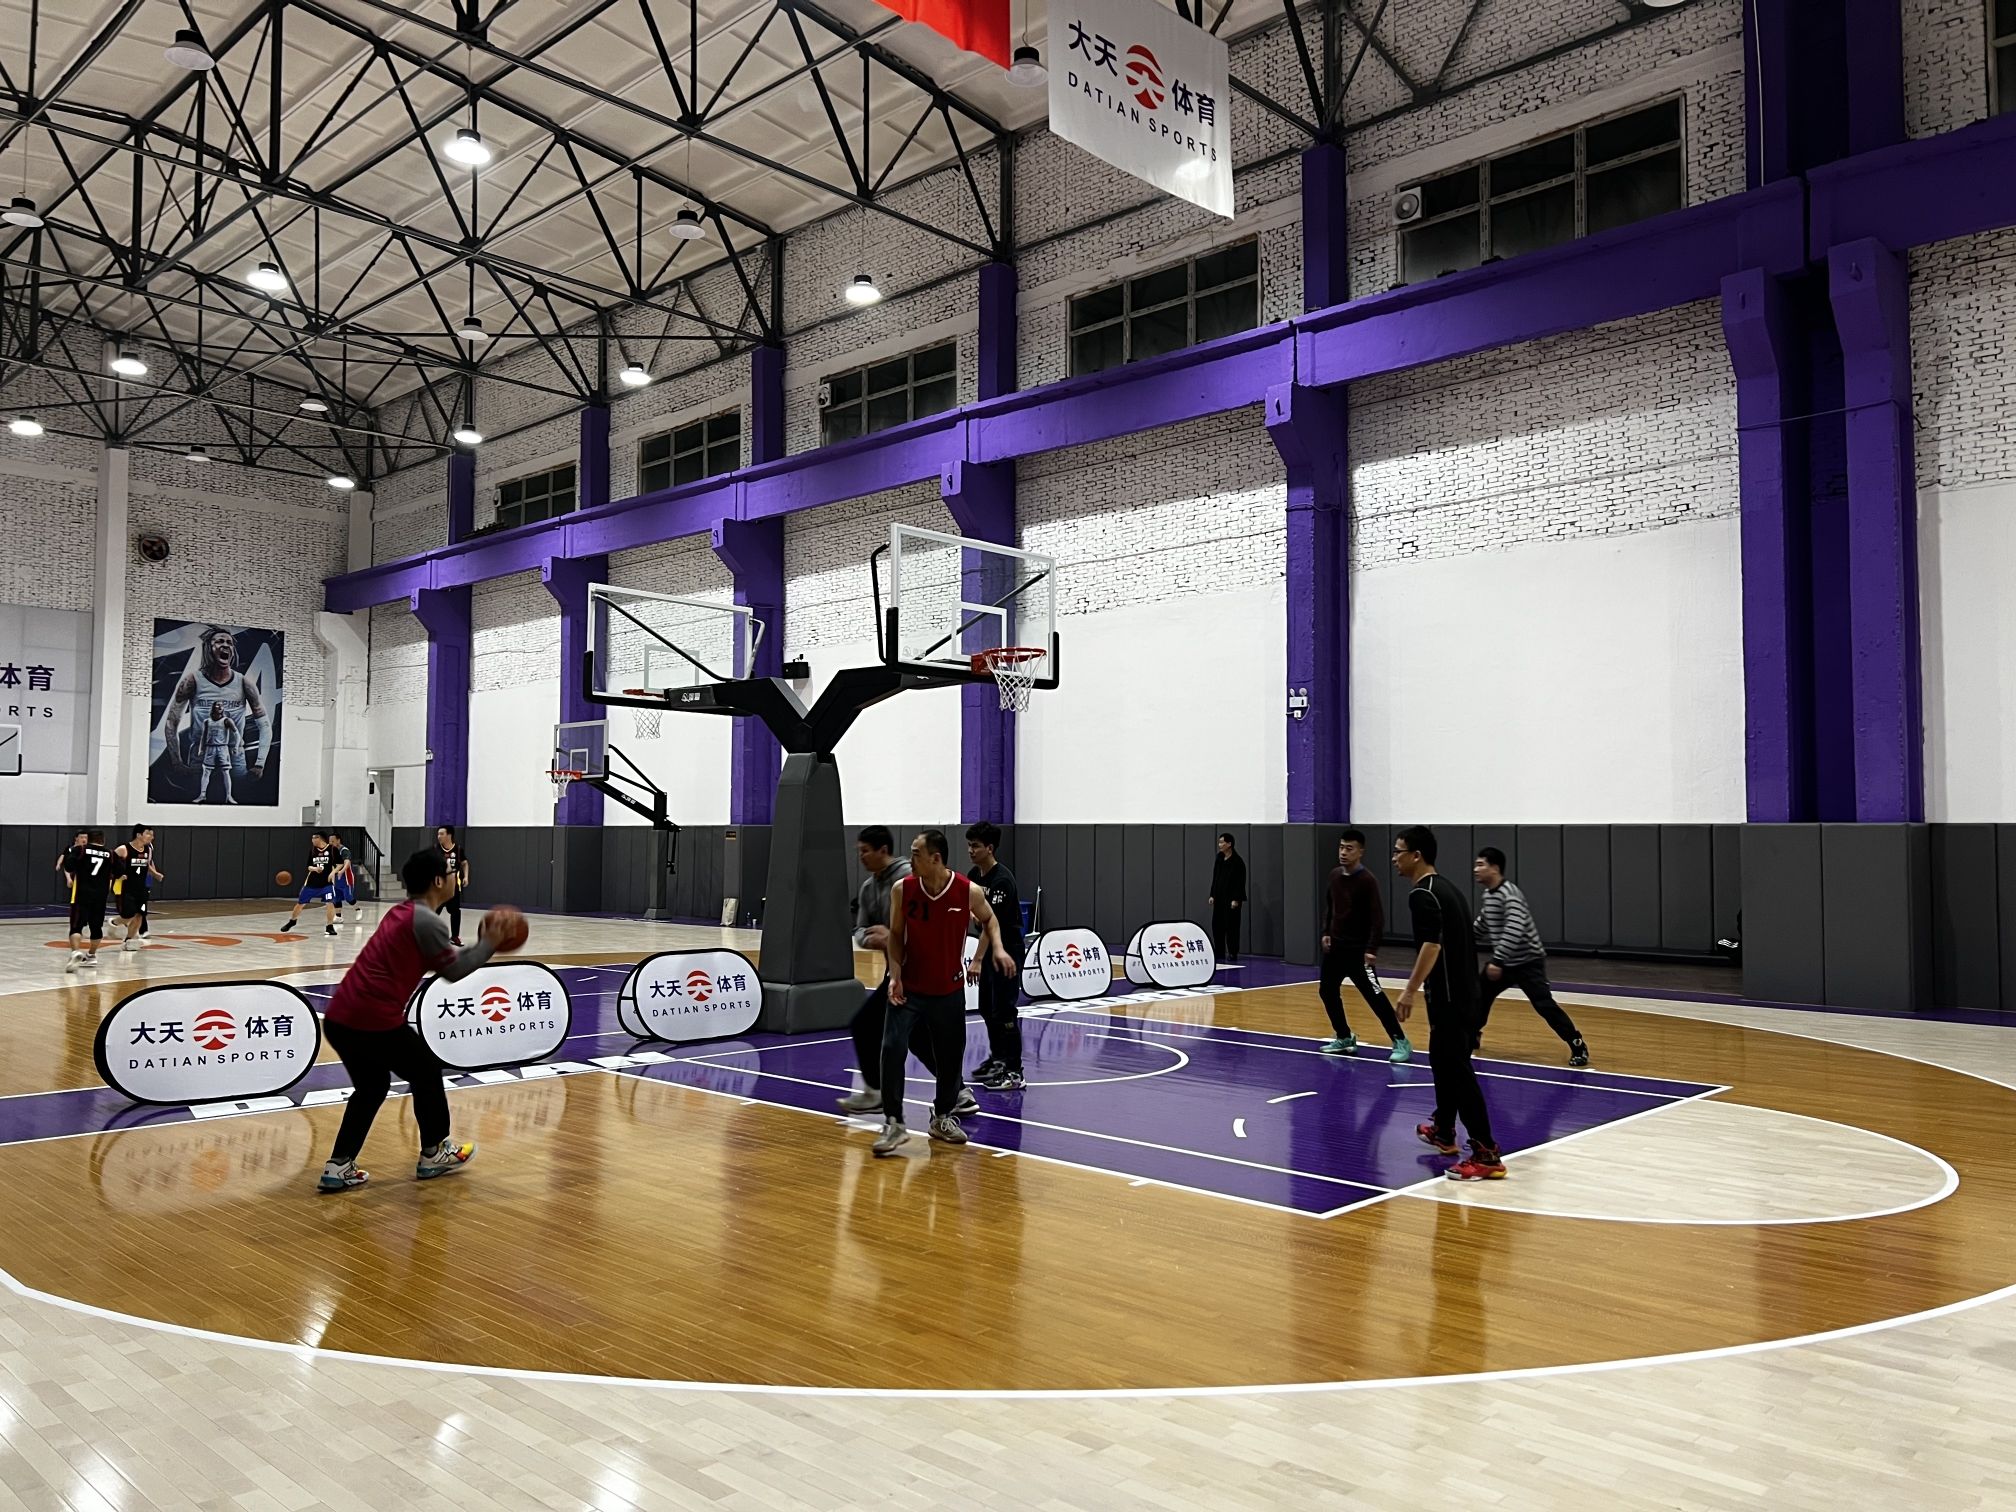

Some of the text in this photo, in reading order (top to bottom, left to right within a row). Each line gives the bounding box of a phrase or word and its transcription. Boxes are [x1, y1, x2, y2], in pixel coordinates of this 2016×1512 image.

[1068, 19, 1215, 127] 大天 体育
[1068, 72, 1217, 161] DATIAN SPORTS
[0, 662, 55, 691] 体育
[0, 705, 53, 718] RTS
[91, 857, 103, 875] 7
[908, 900, 929, 922] 21
[1046, 950, 1066, 966] 大天
[1082, 946, 1101, 962] 体育
[1148, 942, 1168, 956] 大天
[1186, 939, 1204, 953] 体育
[1050, 971, 1077, 981] DATIAN
[1079, 967, 1105, 977] SPORTS
[1152, 958, 1209, 970] DATIAN SPORTS
[649, 974, 746, 998] 大天 体育
[437, 990, 552, 1019] 大天 体育
[652, 1000, 751, 1017] DATIAN SPORTS
[130, 1014, 294, 1045] 大天 体育
[439, 1020, 555, 1040] DATIAN SPORTS
[129, 1049, 295, 1069] DATIAN SPORTS
